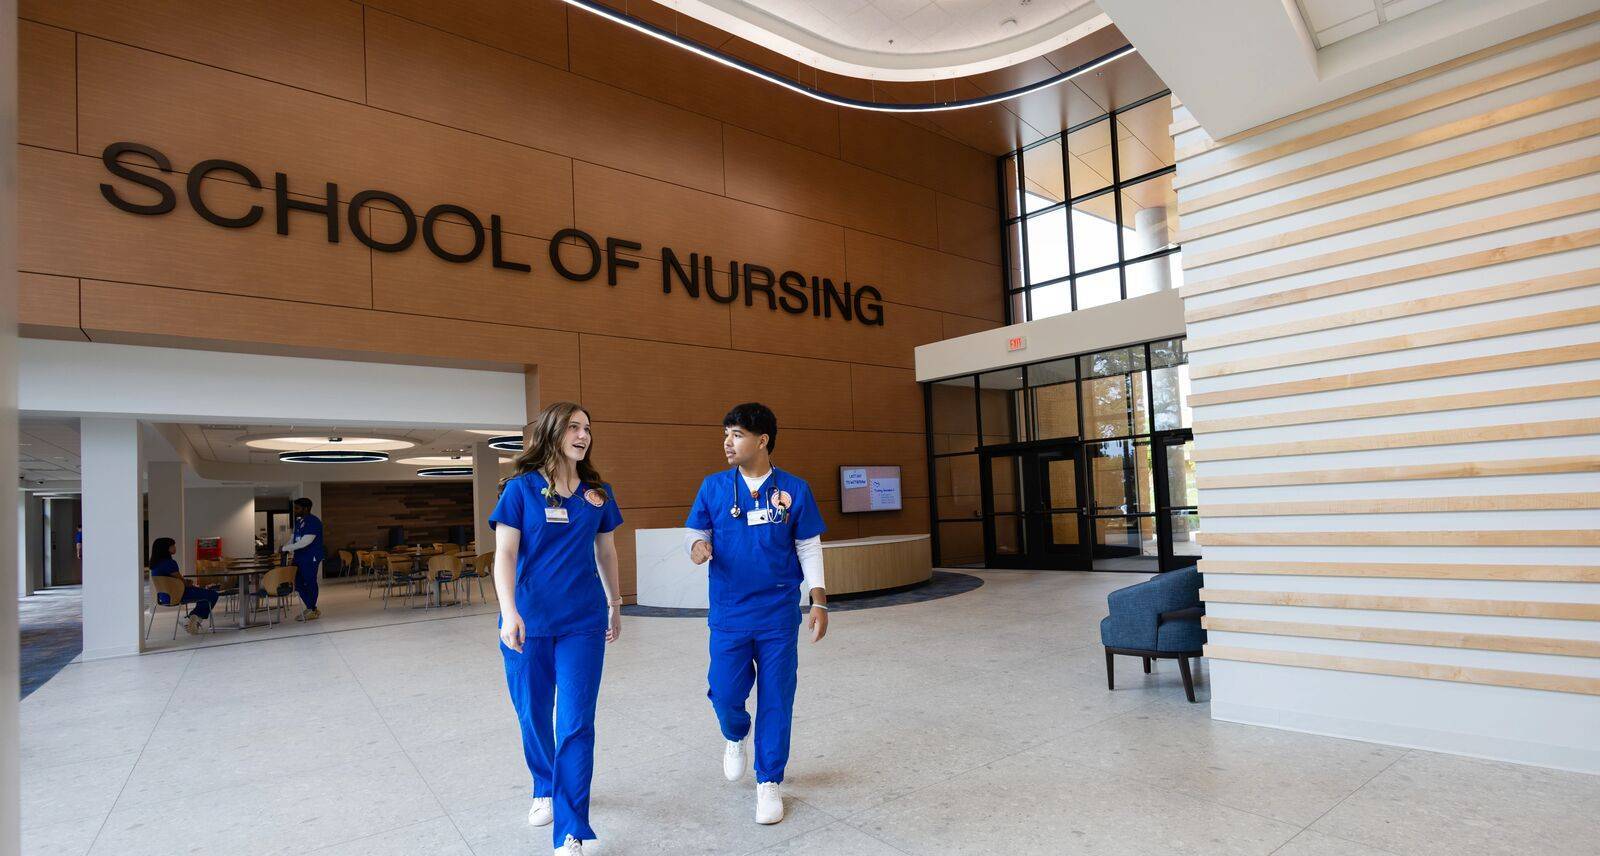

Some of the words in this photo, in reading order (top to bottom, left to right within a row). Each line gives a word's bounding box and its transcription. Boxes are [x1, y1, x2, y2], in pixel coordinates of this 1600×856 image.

[100, 142, 531, 272] SCHOOL
[549, 228, 641, 286] OF
[662, 247, 884, 327] NURSING
[1009, 338, 1023, 349] EXIT
